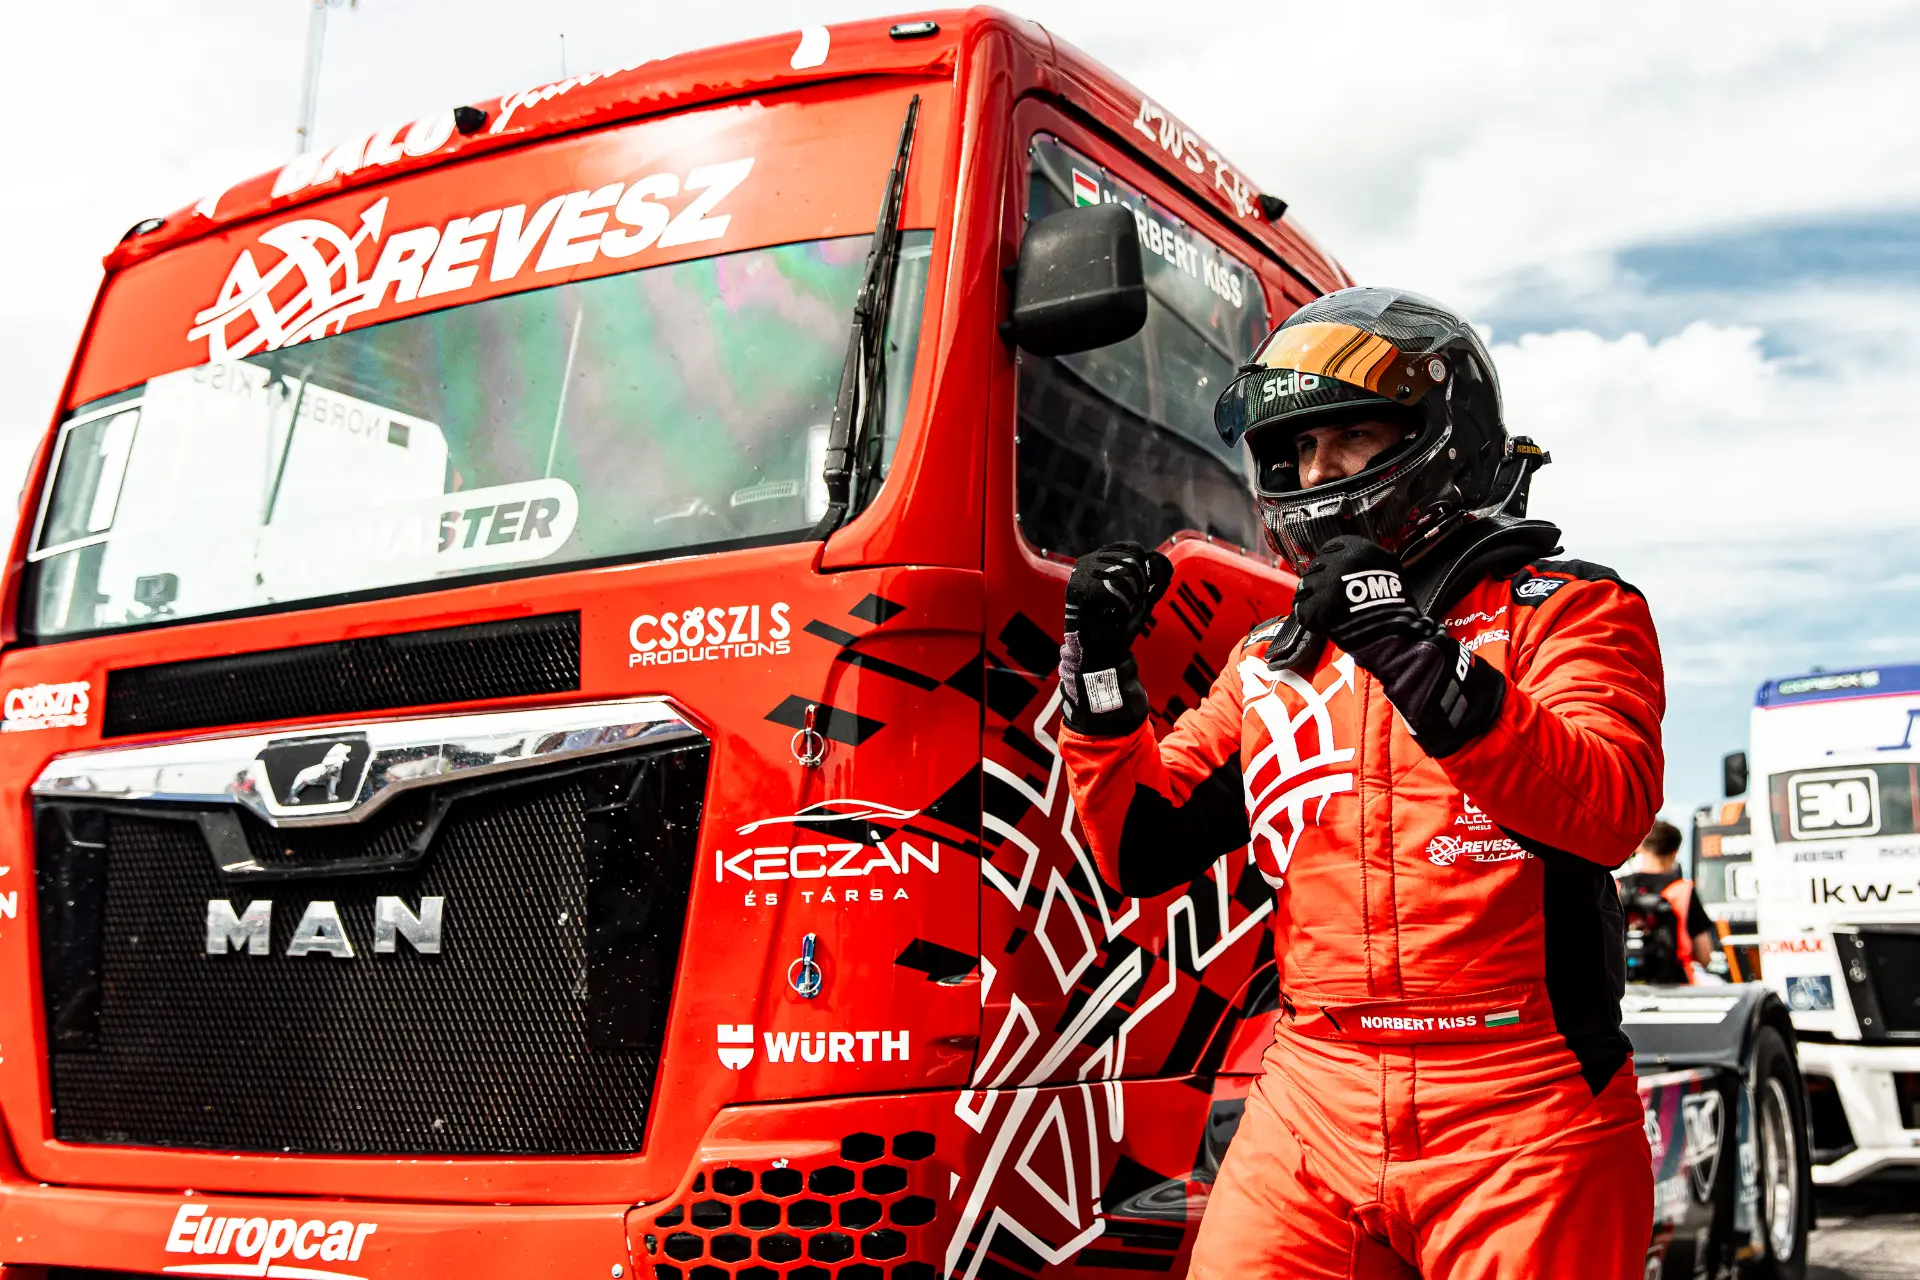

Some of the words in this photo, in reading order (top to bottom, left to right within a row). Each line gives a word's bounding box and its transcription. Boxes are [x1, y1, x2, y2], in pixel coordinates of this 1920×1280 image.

[368, 157, 755, 308] REVESZ
[1203, 254, 1242, 308] KISS
[1345, 575, 1403, 603] OMP
[1519, 581, 1559, 595] OMP
[629, 640, 791, 668] PRODUCTIONS
[1799, 780, 1871, 829] 30
[744, 890, 778, 907] ÉS
[801, 886, 909, 904] TÁRSA
[1811, 877, 1920, 904] lkw-
[207, 896, 444, 958] MAN
[1360, 1016, 1434, 1031] NORBERT
[1438, 1015, 1477, 1031] KISS
[763, 1030, 910, 1063] WÜRTH
[165, 1203, 378, 1276] Europcar
